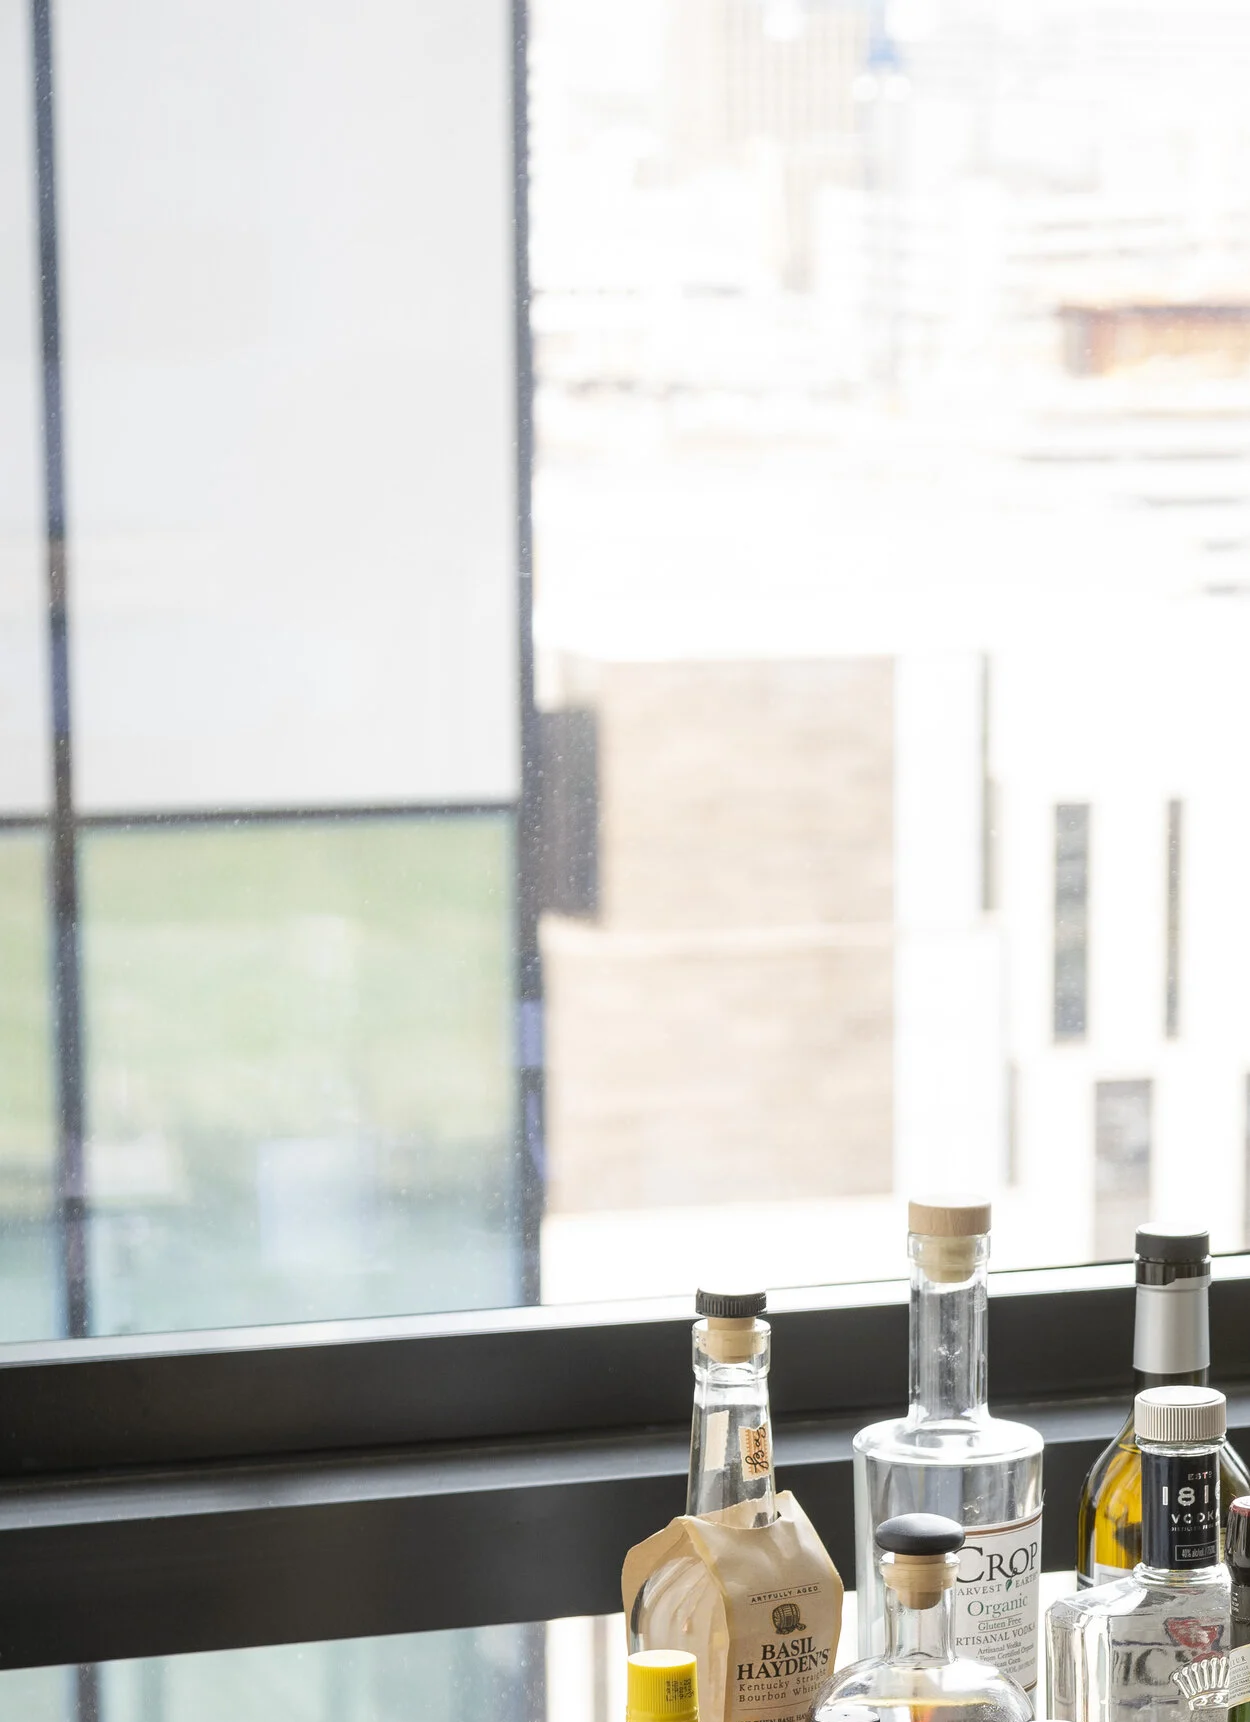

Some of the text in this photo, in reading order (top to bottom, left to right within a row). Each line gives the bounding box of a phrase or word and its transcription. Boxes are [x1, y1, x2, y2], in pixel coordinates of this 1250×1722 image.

[955, 1542, 1038, 1583] CROP
[752, 1586, 818, 1603] ARTFULLY AGED
[957, 1583, 1002, 1596] ARVEST
[968, 1593, 1029, 1618] Organic
[978, 1617, 1022, 1632] Gluten Free
[956, 1631, 1010, 1646] RTISANAL
[761, 1636, 816, 1661] BASIL
[736, 1649, 831, 1681] HAYDEN'S
[739, 1680, 790, 1692] Kentucky
[739, 1692, 786, 1703] Bourbon
